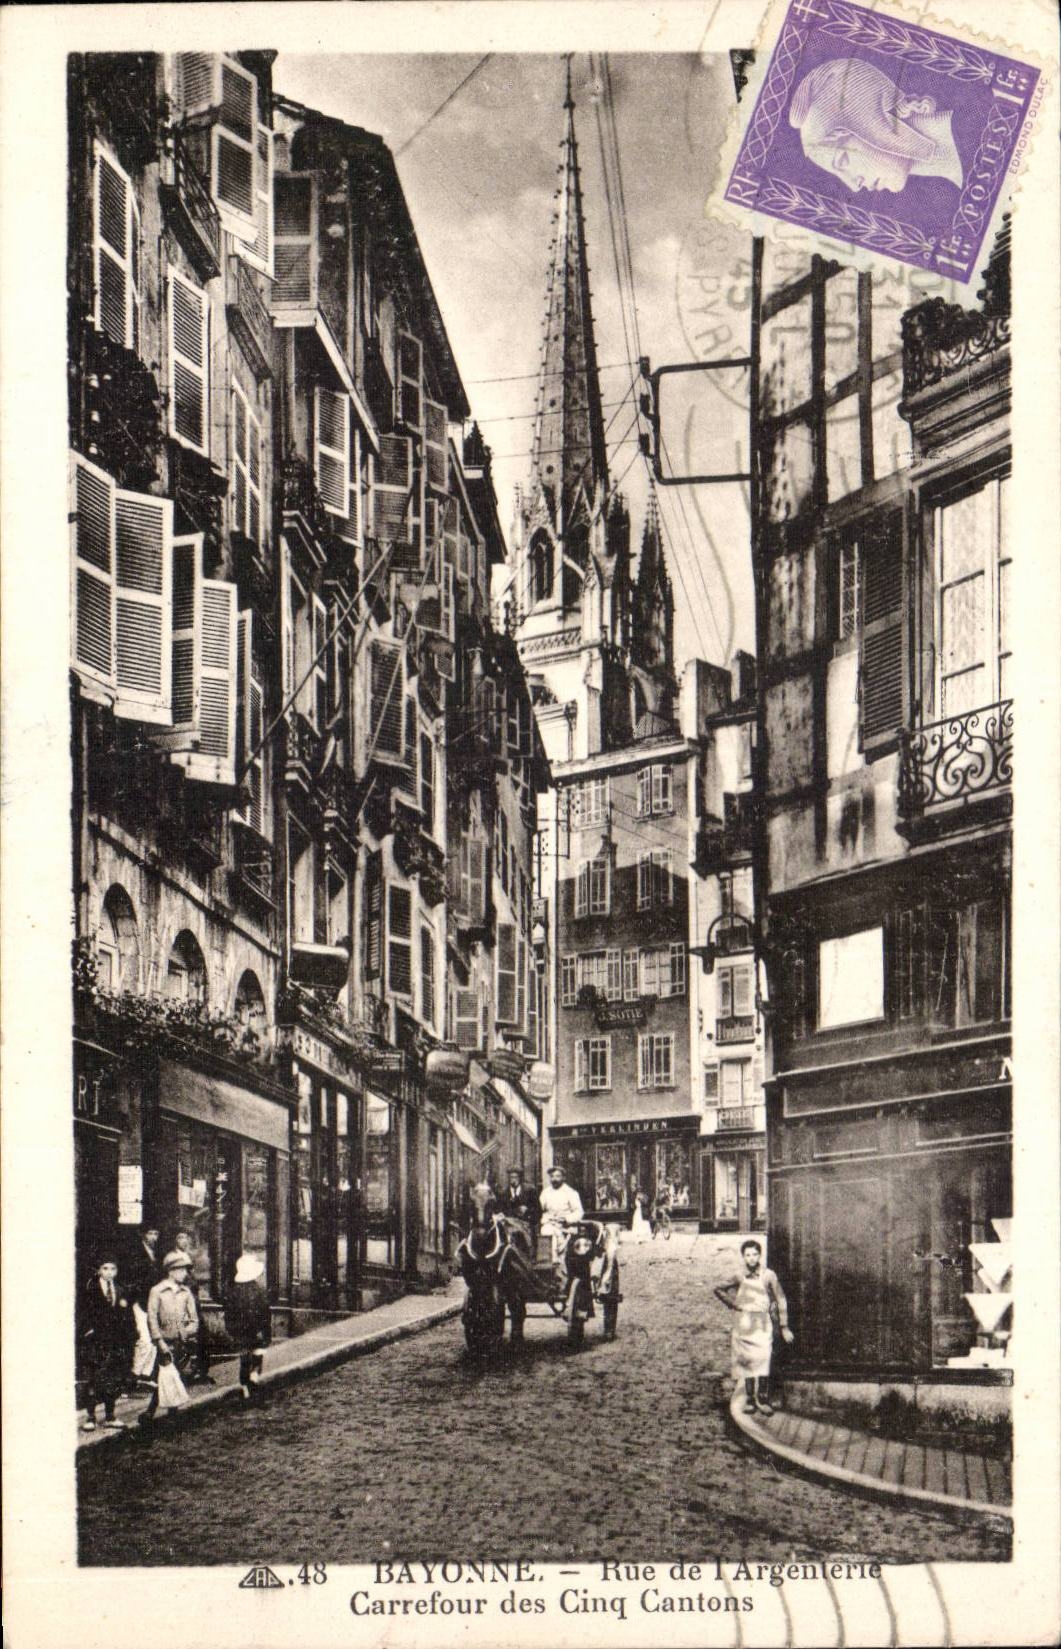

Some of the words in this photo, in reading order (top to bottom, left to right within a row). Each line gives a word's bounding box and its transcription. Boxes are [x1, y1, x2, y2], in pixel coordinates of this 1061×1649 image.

[963, 124, 1008, 218] POSTES
[1009, 121, 1034, 175] EDMOND
[1029, 77, 1049, 118] DULAC
[727, 174, 760, 206] RF
